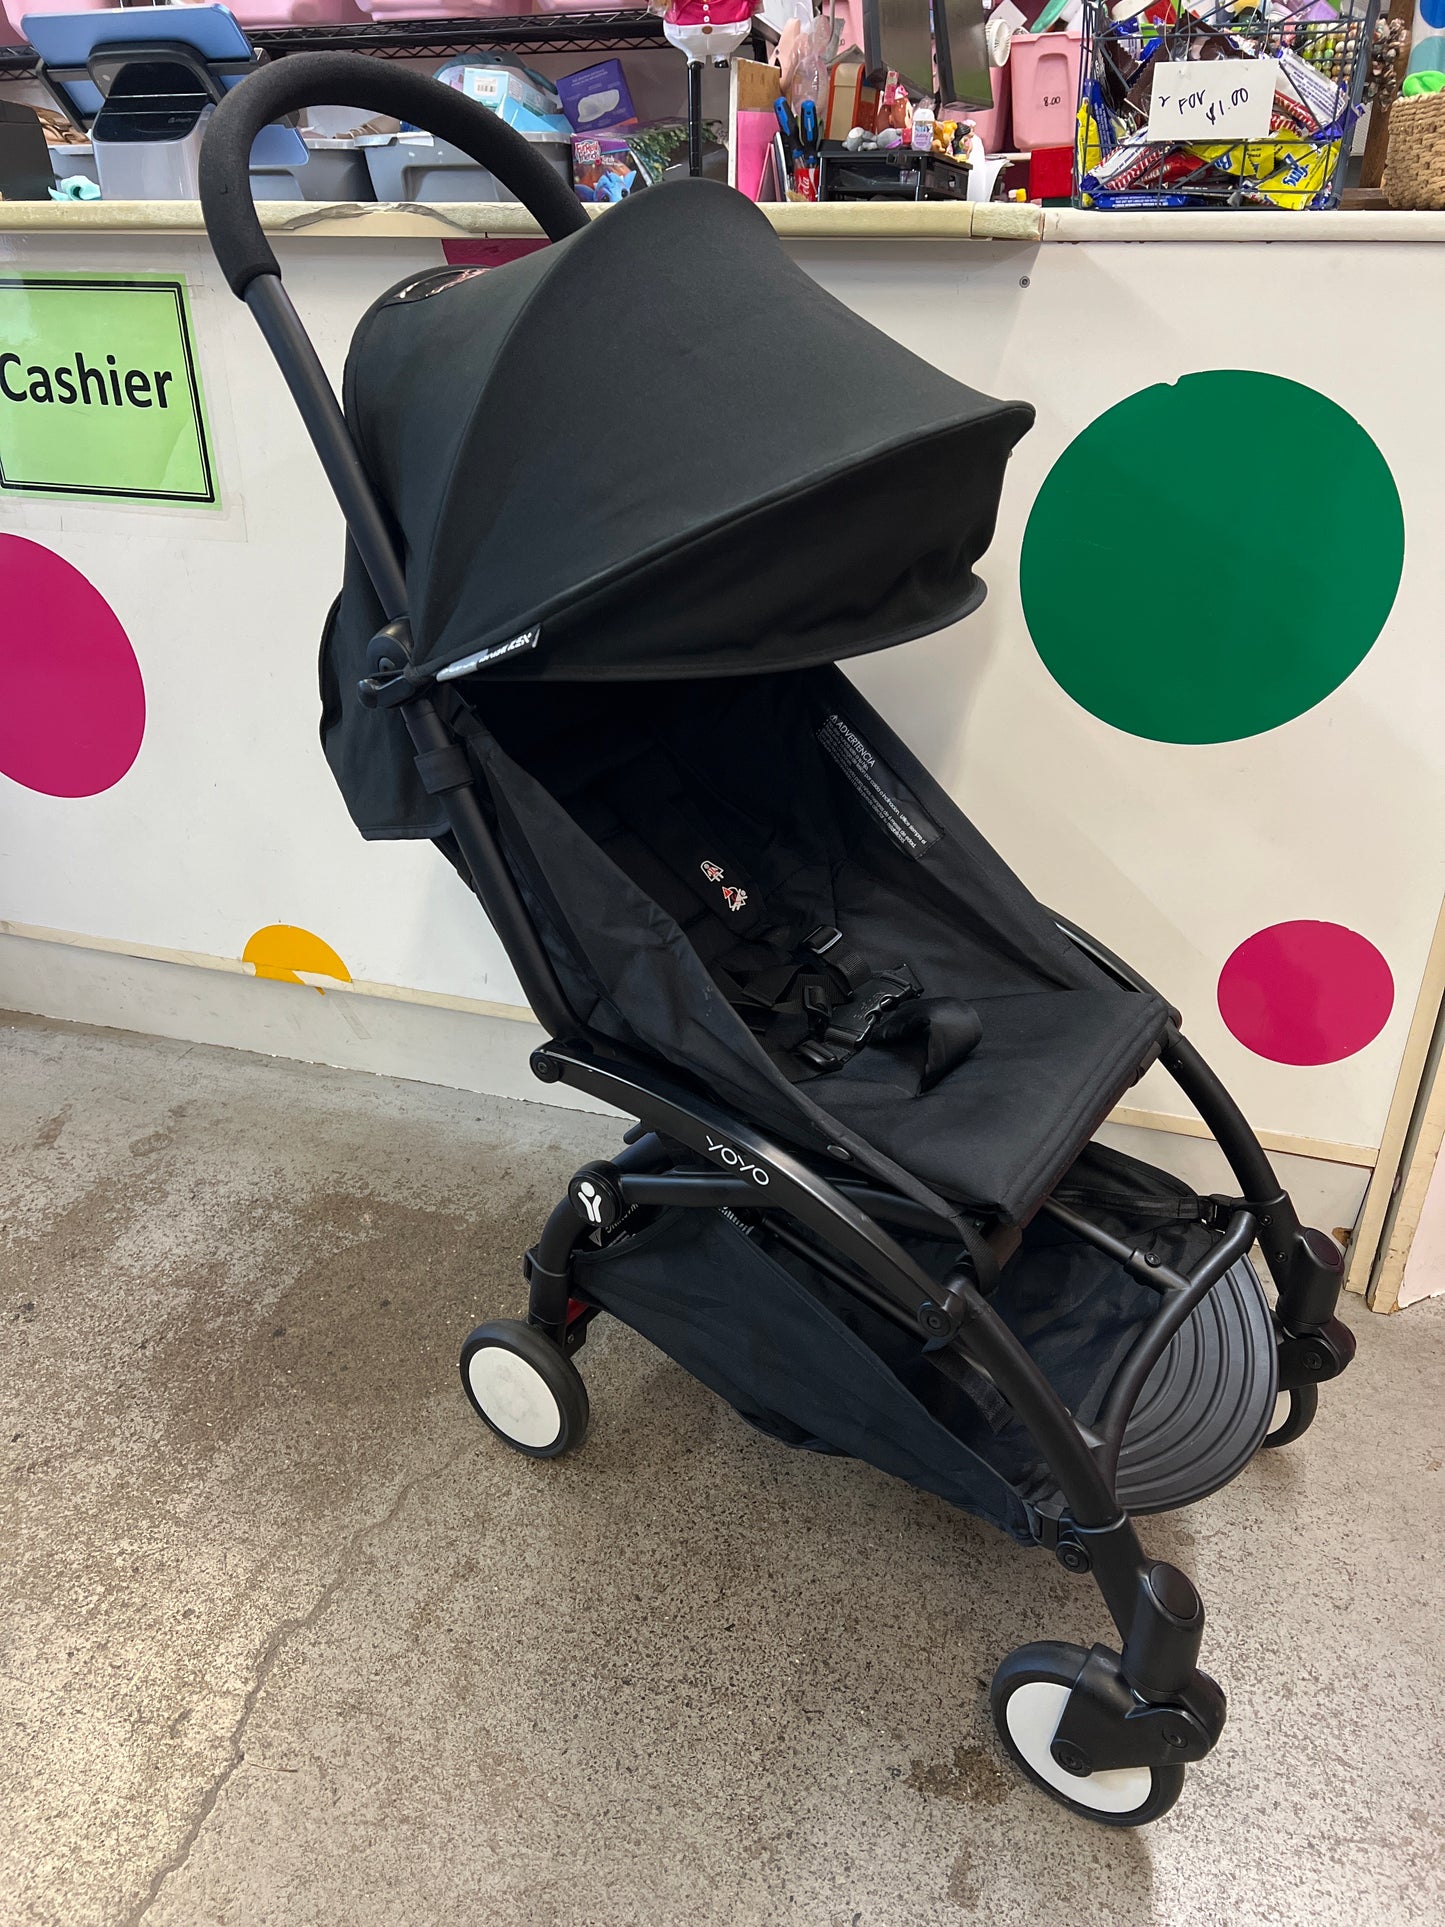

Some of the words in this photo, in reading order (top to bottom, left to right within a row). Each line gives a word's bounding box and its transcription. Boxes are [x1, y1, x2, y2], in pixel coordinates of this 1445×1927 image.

[1043, 96, 1061, 107] 8.00
[1178, 89, 1206, 115] FOR
[1205, 87, 1249, 126] $1.00
[0, 352, 173, 409] Cashier
[836, 721, 876, 768] ADVERTENCIA
[705, 1135, 770, 1186] YOYO
